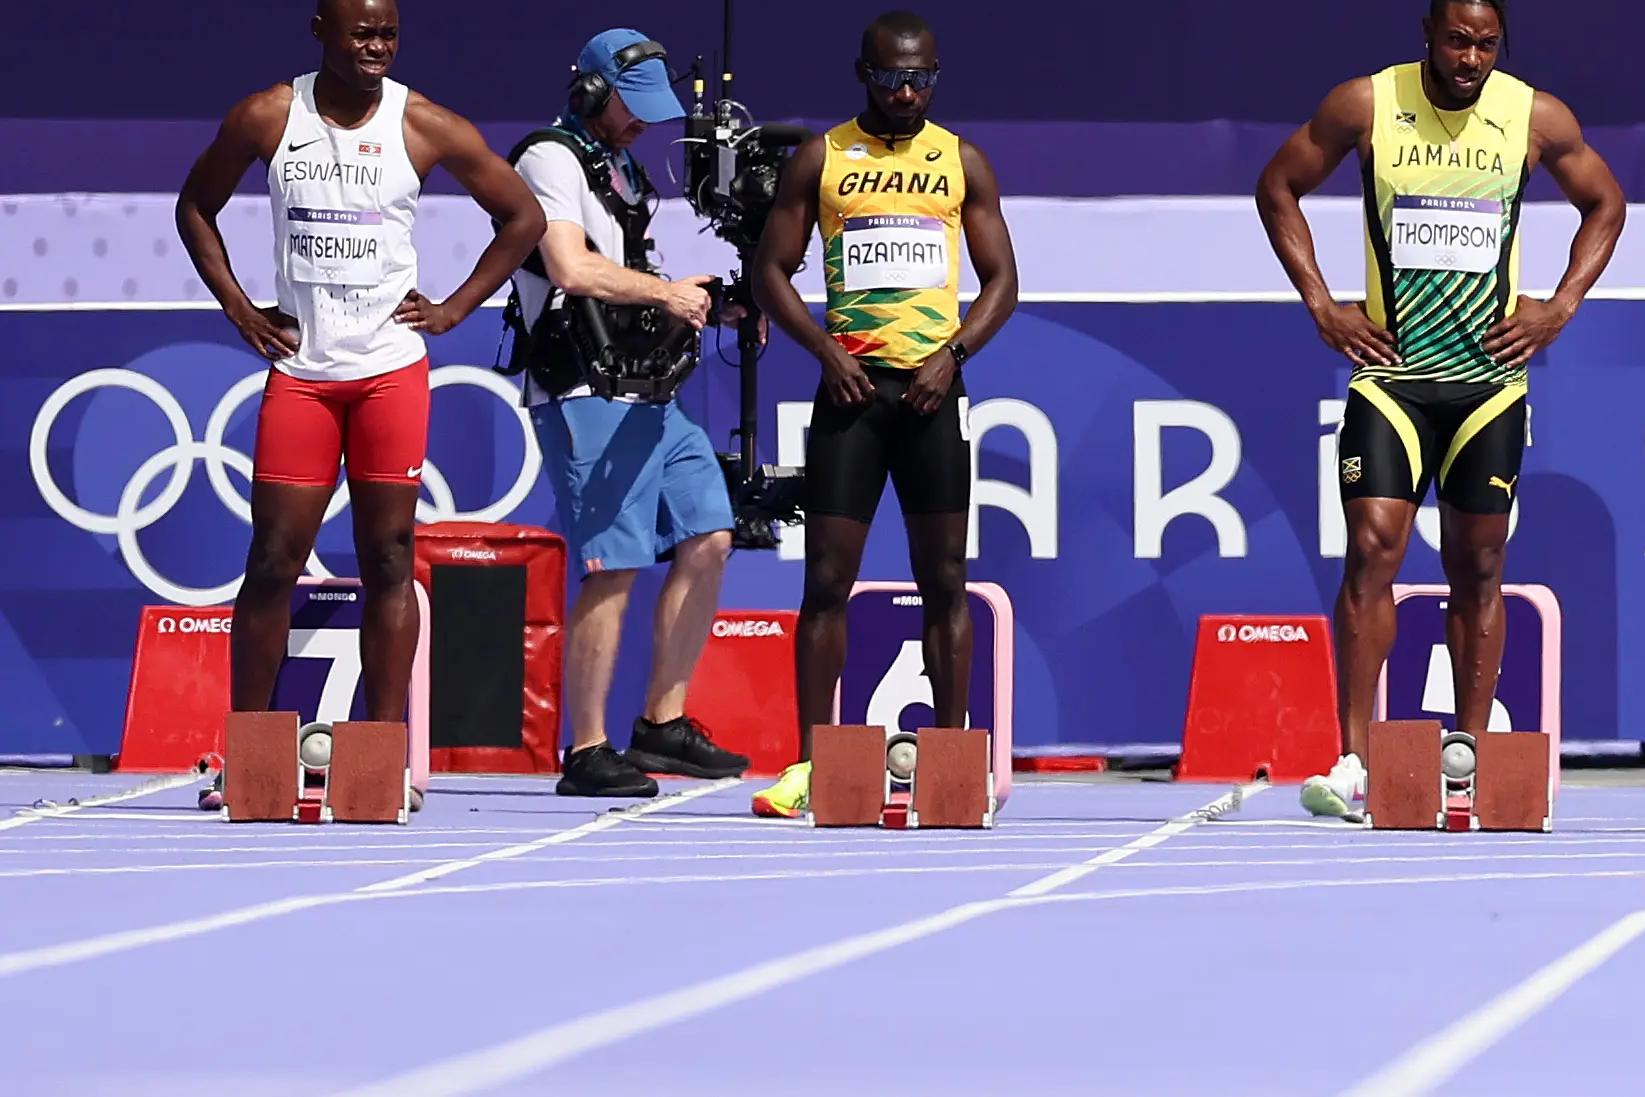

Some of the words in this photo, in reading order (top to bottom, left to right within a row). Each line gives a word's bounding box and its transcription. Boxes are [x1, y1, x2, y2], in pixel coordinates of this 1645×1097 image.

[1392, 144, 1504, 175] JAMAICA
[283, 161, 382, 186] ESWATINI
[837, 171, 949, 197] GHANA
[1421, 198, 1449, 208] PARIS
[1451, 200, 1475, 209] 2024
[868, 216, 895, 226] PARIS
[897, 217, 920, 227] 2024
[1396, 222, 1497, 249] THOMPSON
[290, 233, 377, 260] MATSENJWA
[847, 241, 943, 266] AZAMATI
[464, 550, 496, 561] OMEGA
[317, 592, 357, 602] MONDO
[179, 618, 232, 633] OMEG
[712, 620, 784, 637] OMEGA
[1238, 625, 1309, 643] OMEGA
[287, 628, 362, 724] 7
